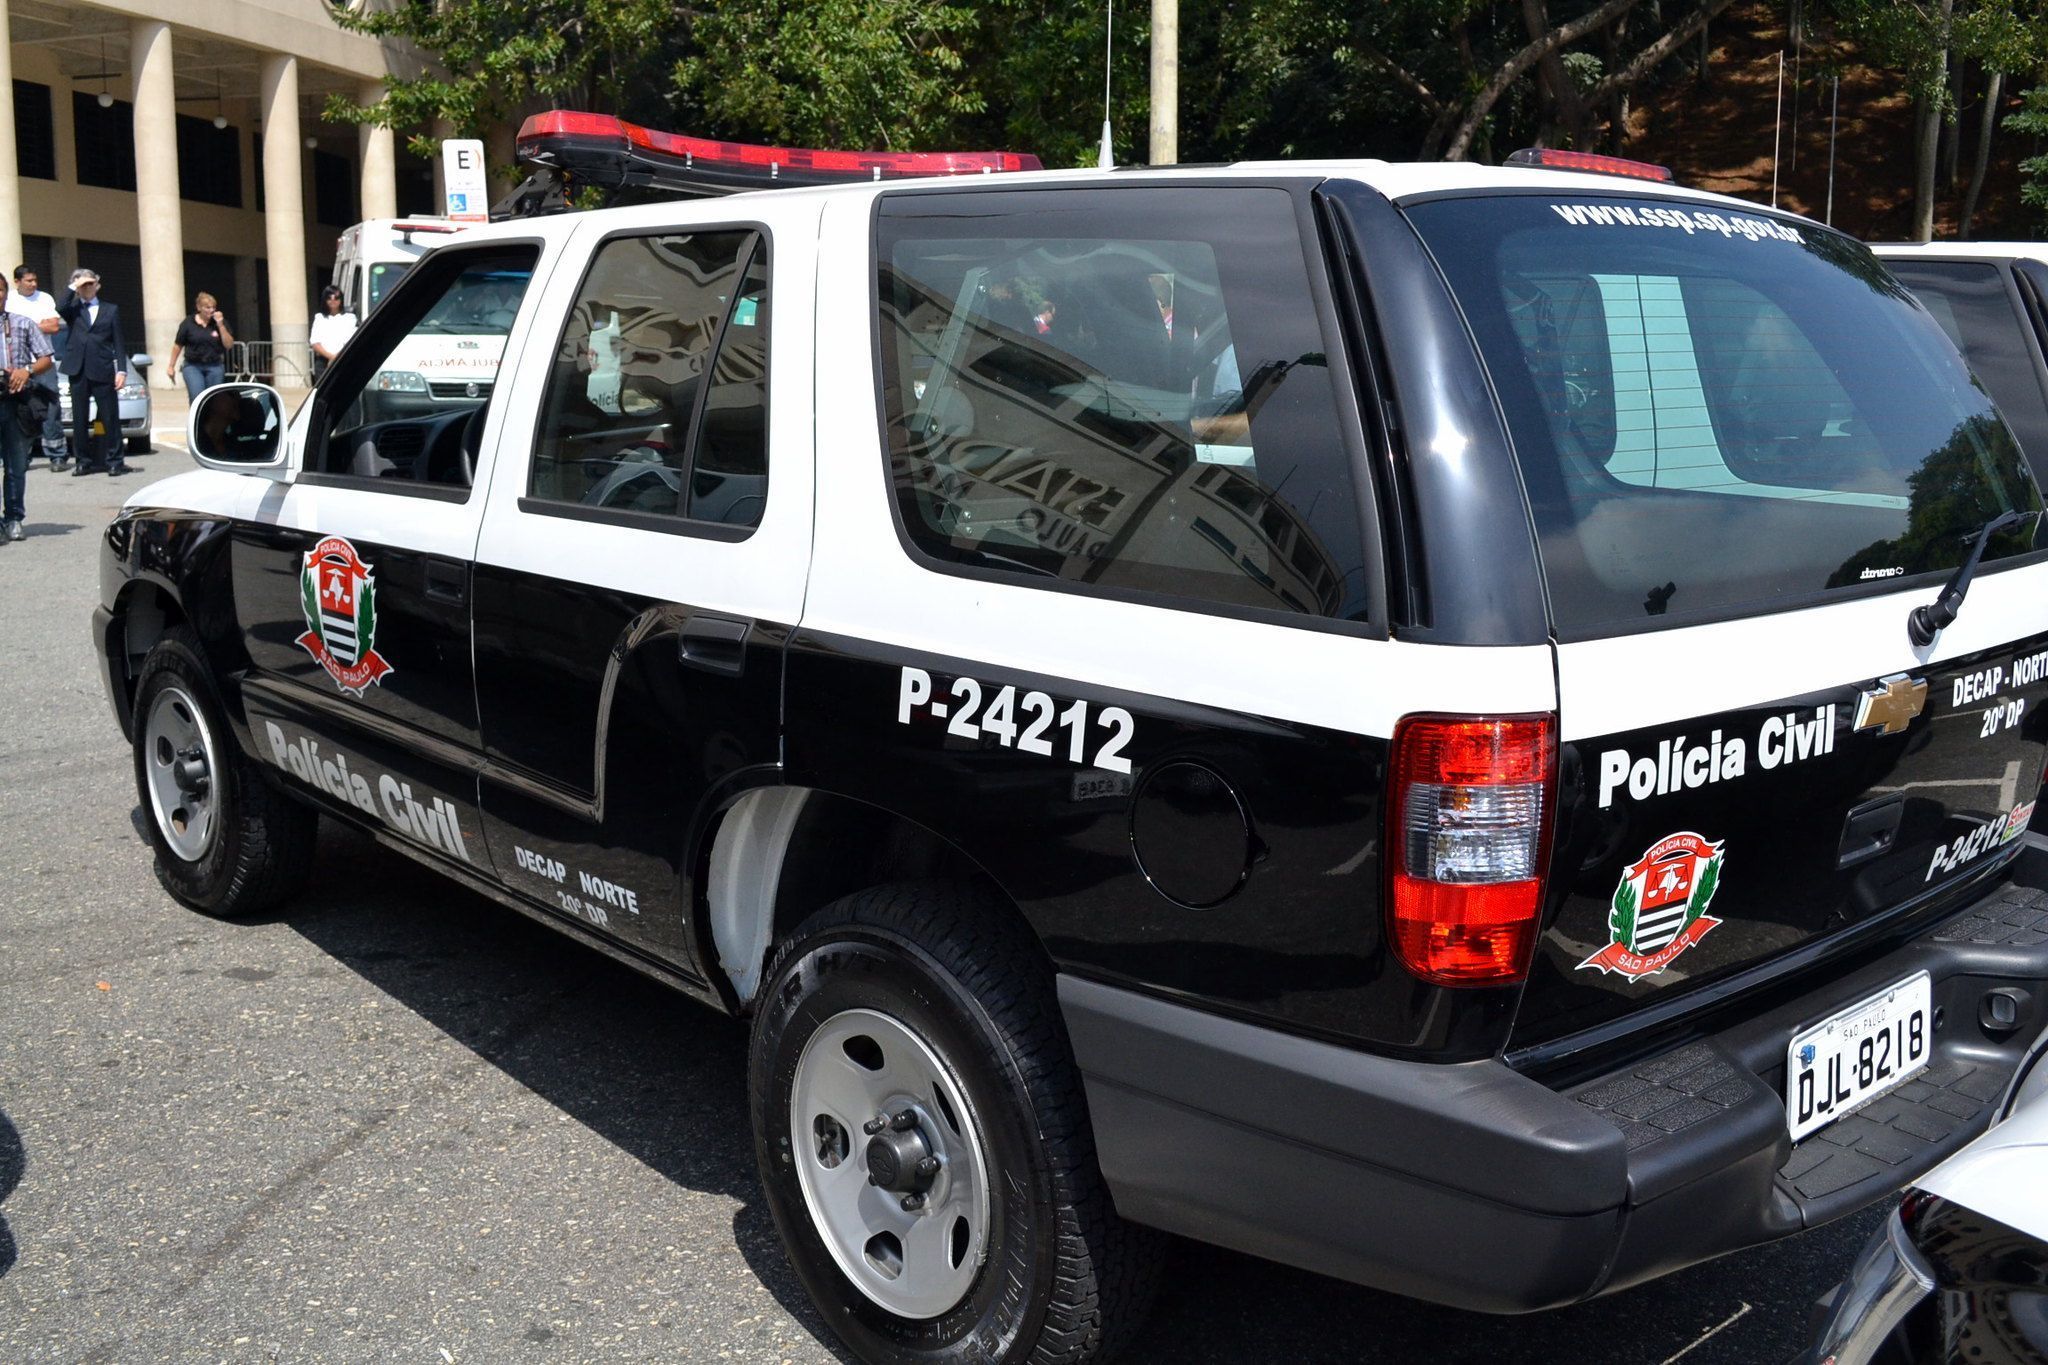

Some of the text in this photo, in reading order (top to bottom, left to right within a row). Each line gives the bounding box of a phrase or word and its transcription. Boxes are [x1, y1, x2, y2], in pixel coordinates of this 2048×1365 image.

[457, 150, 470, 170] E
[1550, 204, 1806, 245] www.ssp.sp.gov.br
[343, 662, 370, 682] PAULO
[1952, 665, 2002, 708] DECAP
[898, 665, 1135, 775] P-24212
[2005, 698, 2025, 729] DP
[1598, 703, 1836, 809] Polícia Civil
[265, 720, 471, 863] Polícia Civil
[1681, 838, 1698, 850] CIVIL
[1924, 813, 2008, 882] P-24212
[514, 845, 640, 915] DECAP NORTE
[584, 902, 608, 928] DP
[1644, 933, 1690, 970] PAULO
[1863, 1008, 1886, 1031] PAULO
